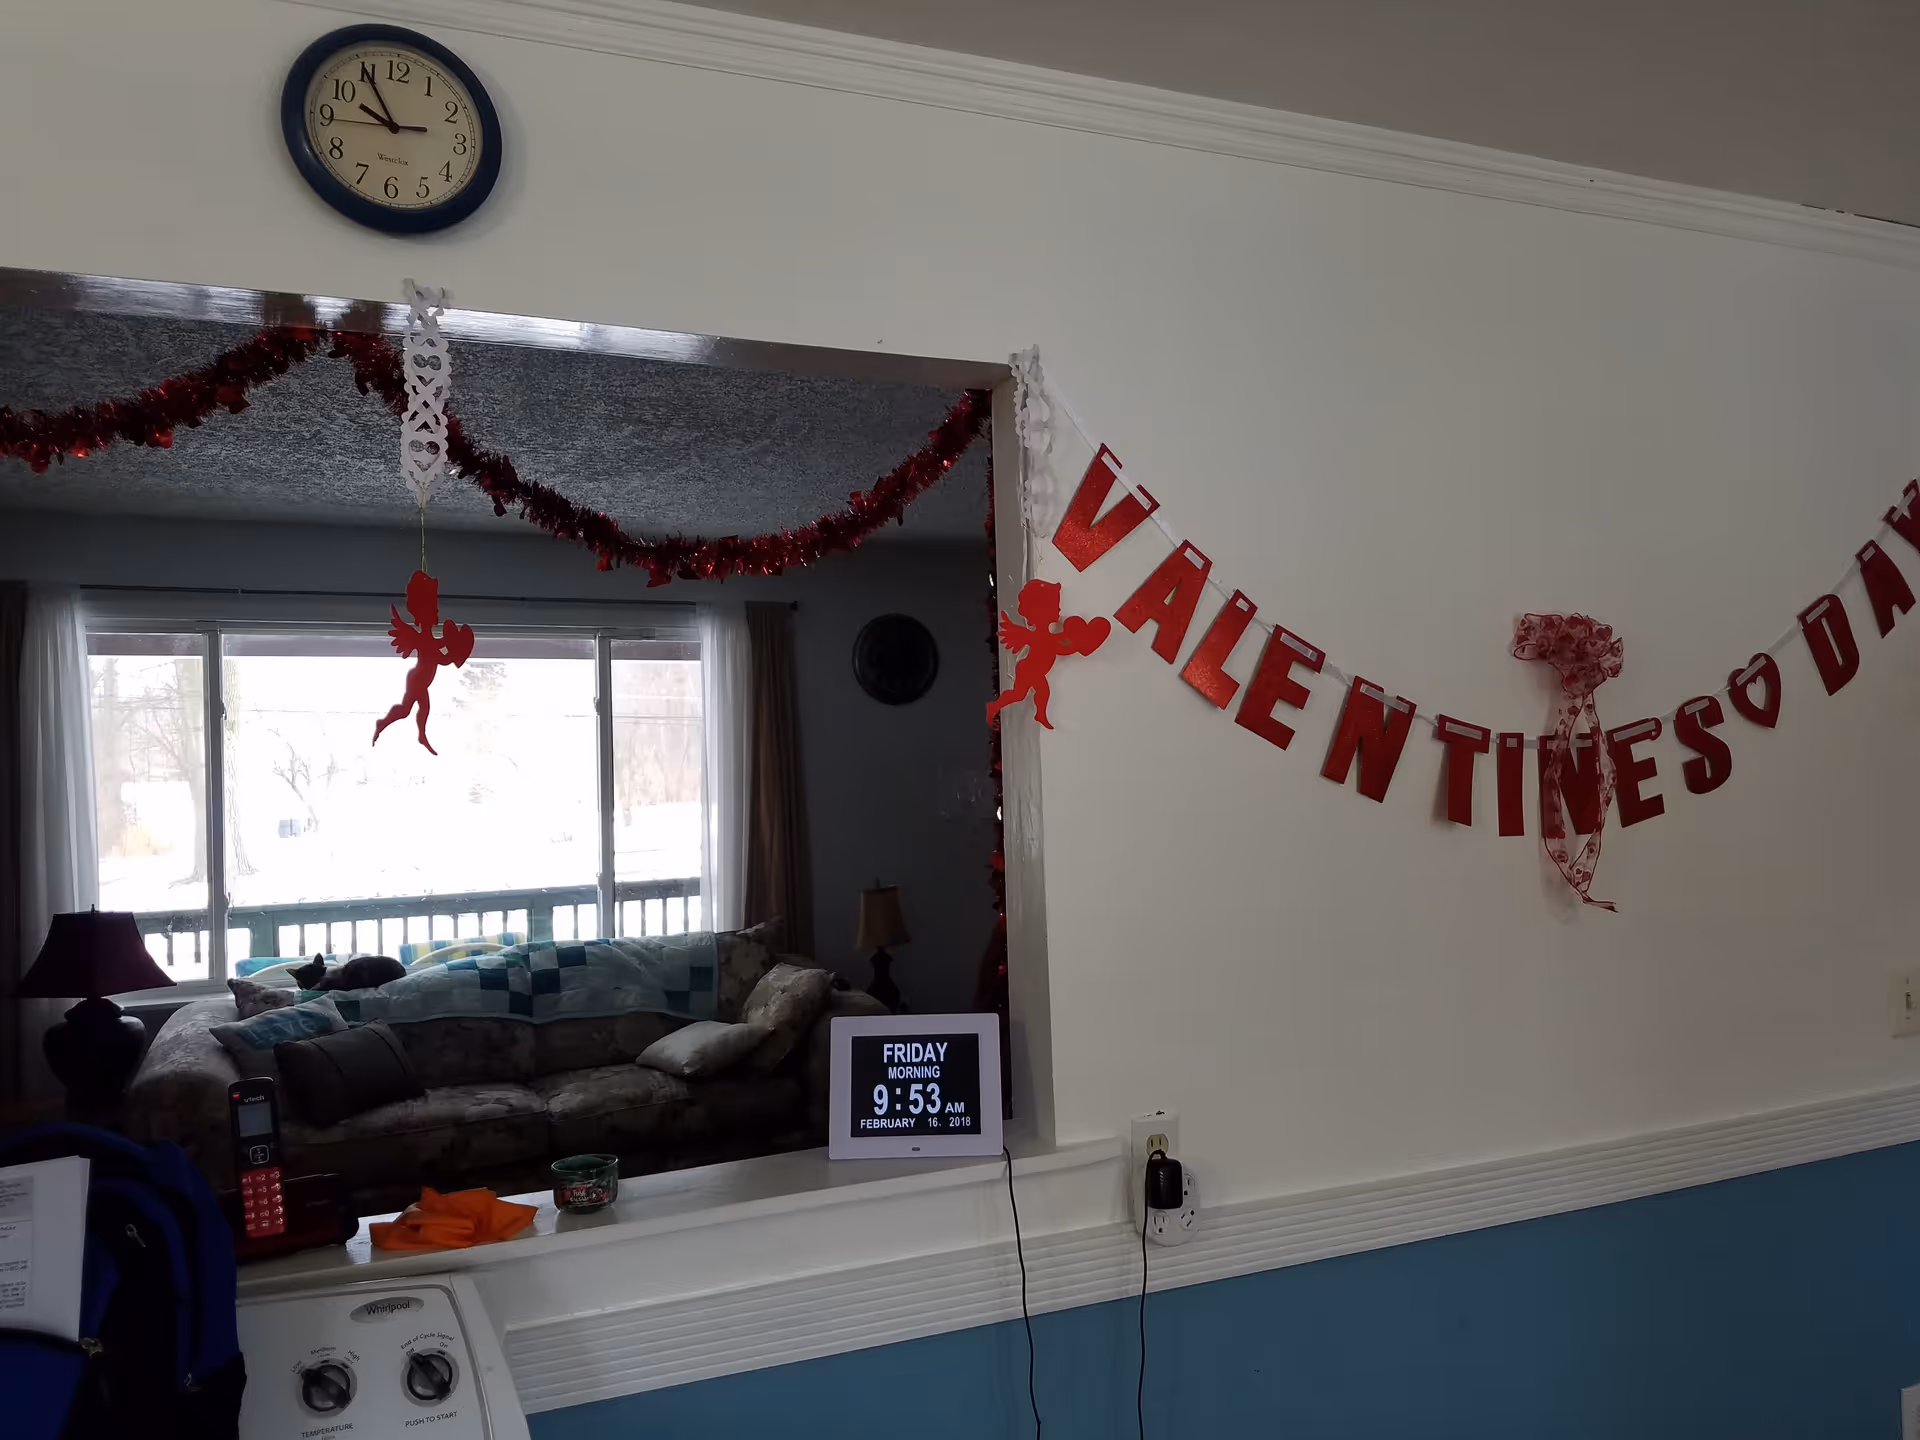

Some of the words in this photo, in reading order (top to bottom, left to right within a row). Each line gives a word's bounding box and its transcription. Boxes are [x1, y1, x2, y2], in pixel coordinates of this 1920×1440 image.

[385, 60, 410, 84] 12
[332, 78, 356, 103] 10
[424, 76, 433, 97] 1
[319, 103, 334, 126] 9
[444, 101, 458, 124] 2
[329, 137, 343, 159] 8
[453, 133, 467, 155] 3
[356, 162, 369, 185] 7
[438, 160, 453, 183] 4
[383, 176, 399, 199] 6
[416, 177, 430, 199] 5
[1052, 443, 1733, 837] VALENTINES
[883, 1042, 948, 1063] FRIDAY
[888, 1065, 940, 1079] MORNING
[873, 1082, 941, 1115] 9:53
[945, 1102, 965, 1113] AM
[860, 1118, 916, 1129] FEBRUARY
[949, 1116, 971, 1127] 2018
[366, 1300, 410, 1315] Whirlpool
[400, 1340, 412, 1350] End
[412, 1335, 419, 1343] of
[419, 1331, 436, 1341] Cycle
[436, 1331, 455, 1342] Signal
[439, 1341, 449, 1349] On
[348, 1349, 361, 1362] High
[405, 1417, 425, 1428] PUSH
[425, 1415, 436, 1423] TO
[436, 1410, 458, 1421] START
[300, 1422, 354, 1439] TEMPERATURE
